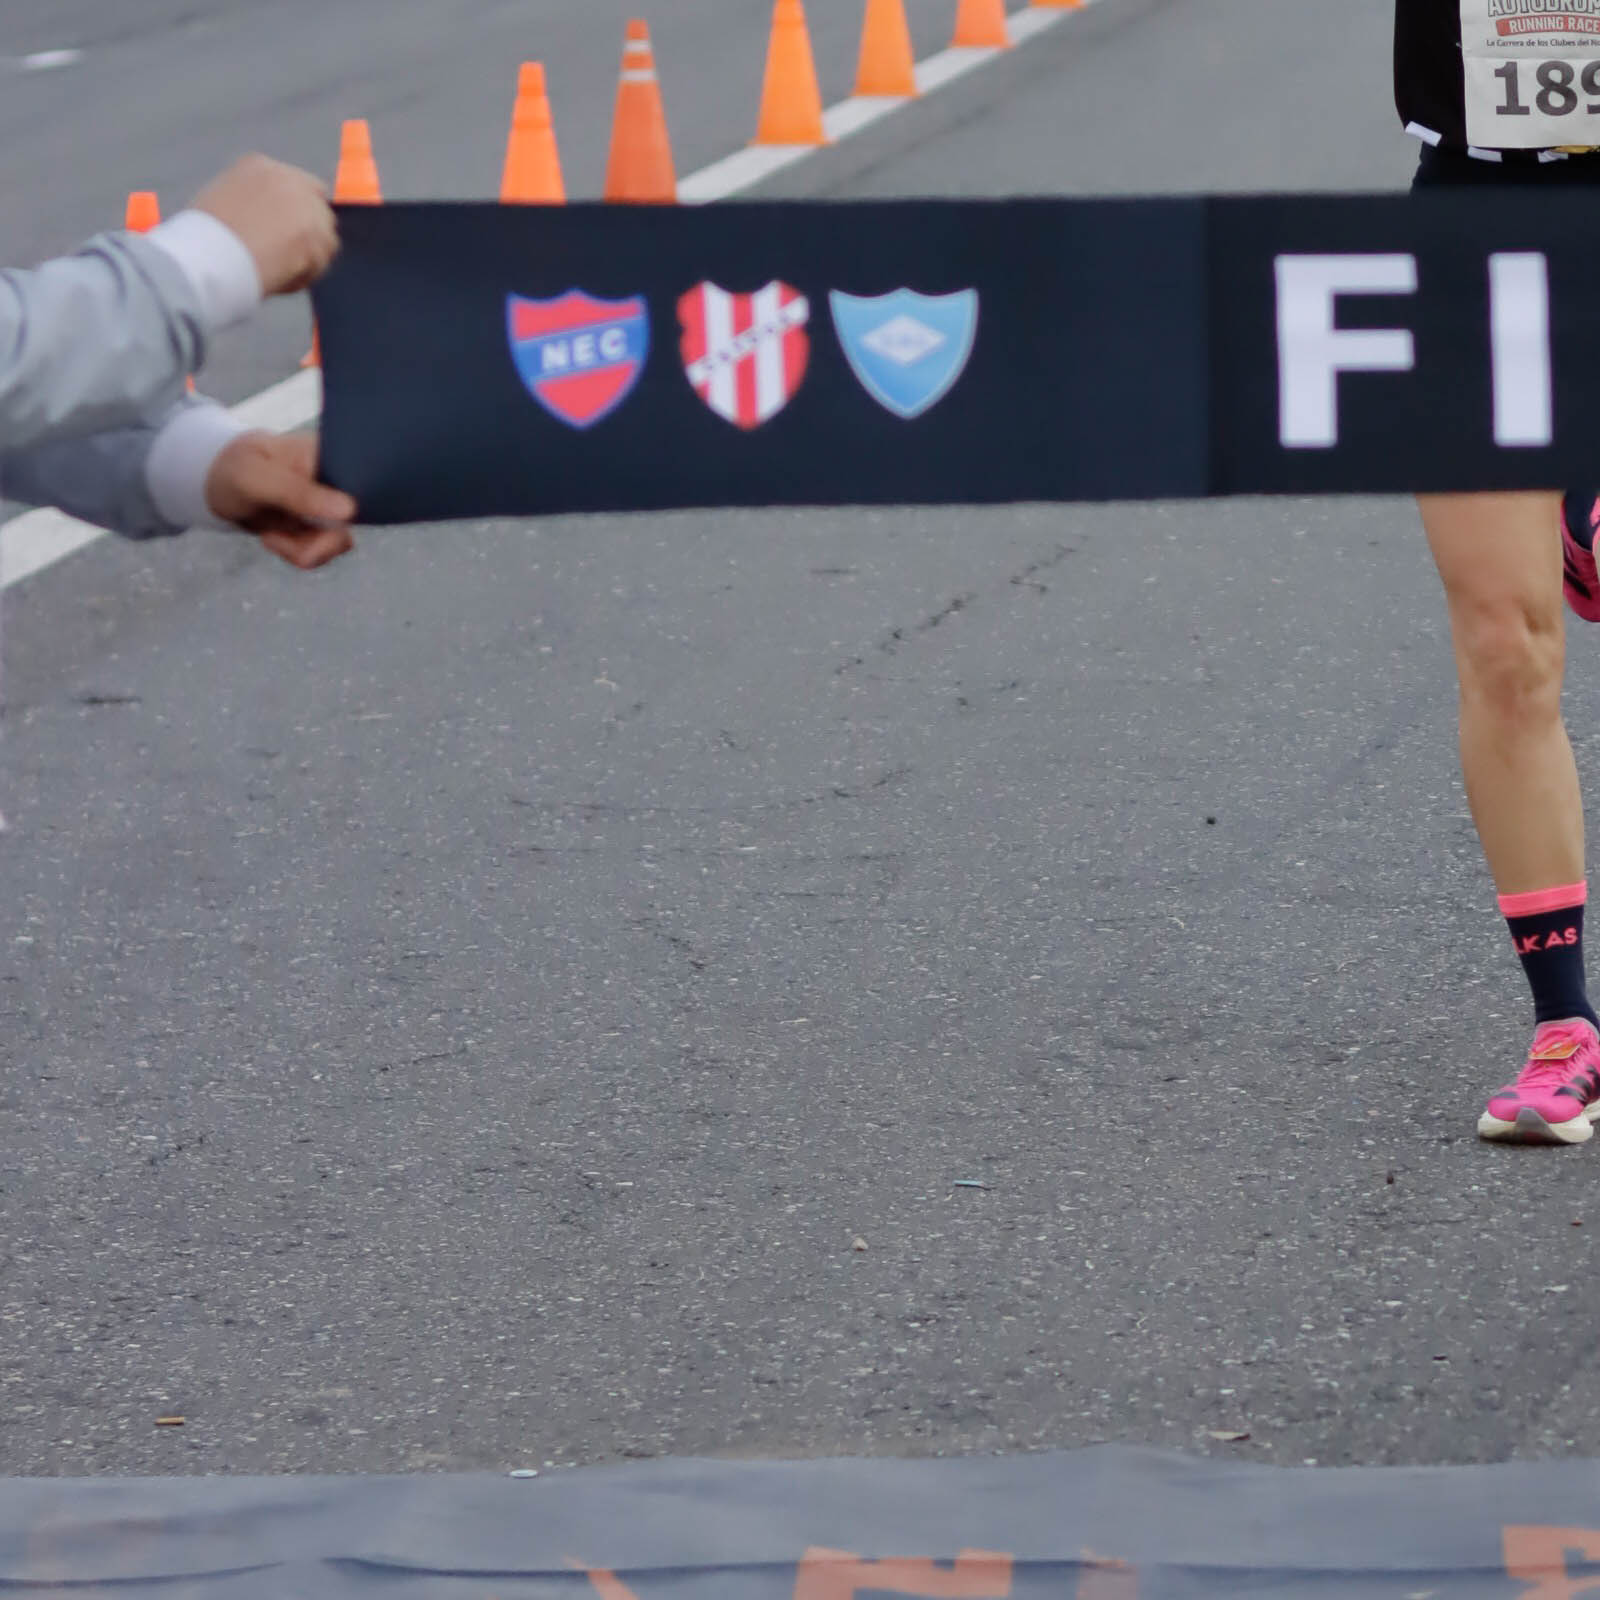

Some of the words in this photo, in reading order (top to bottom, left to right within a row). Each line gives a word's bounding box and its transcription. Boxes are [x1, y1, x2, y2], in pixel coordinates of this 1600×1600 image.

[1509, 16, 1565, 34] RUNNING
[1568, 16, 1600, 33] RACE
[541, 327, 627, 370] NEC
